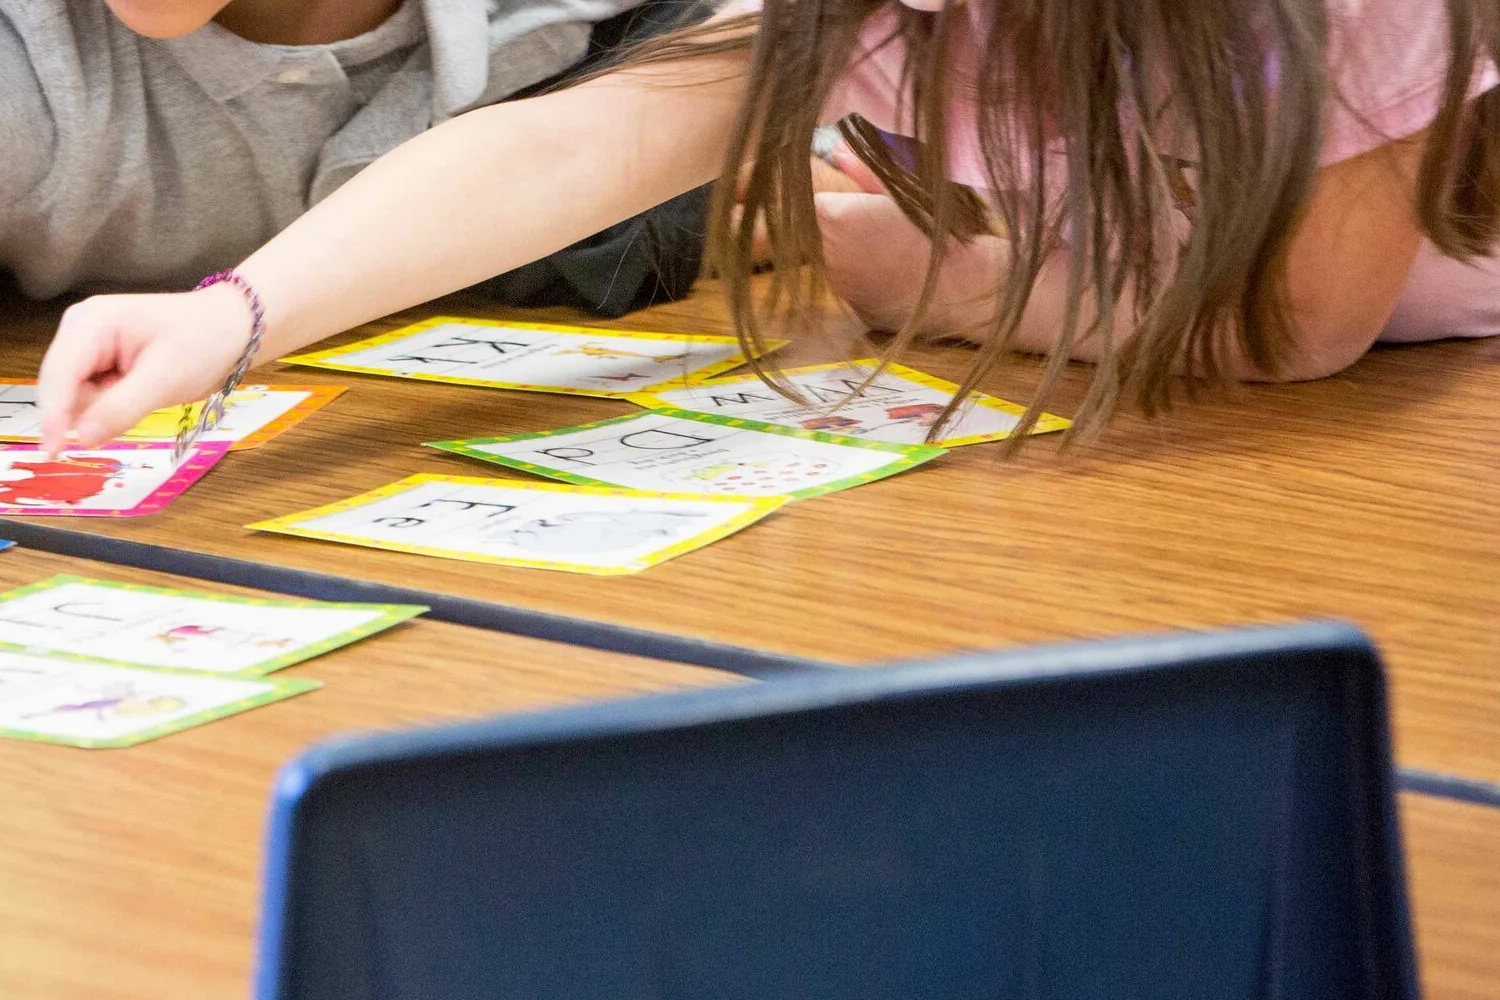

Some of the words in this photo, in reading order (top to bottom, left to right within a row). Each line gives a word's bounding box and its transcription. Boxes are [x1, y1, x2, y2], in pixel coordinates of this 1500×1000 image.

[432, 337, 528, 353] K
[388, 356, 478, 364] k
[803, 379, 903, 402] W
[711, 393, 773, 406] w
[619, 429, 714, 450] D
[533, 448, 595, 466] d
[420, 499, 516, 517] E
[373, 517, 425, 528] e
